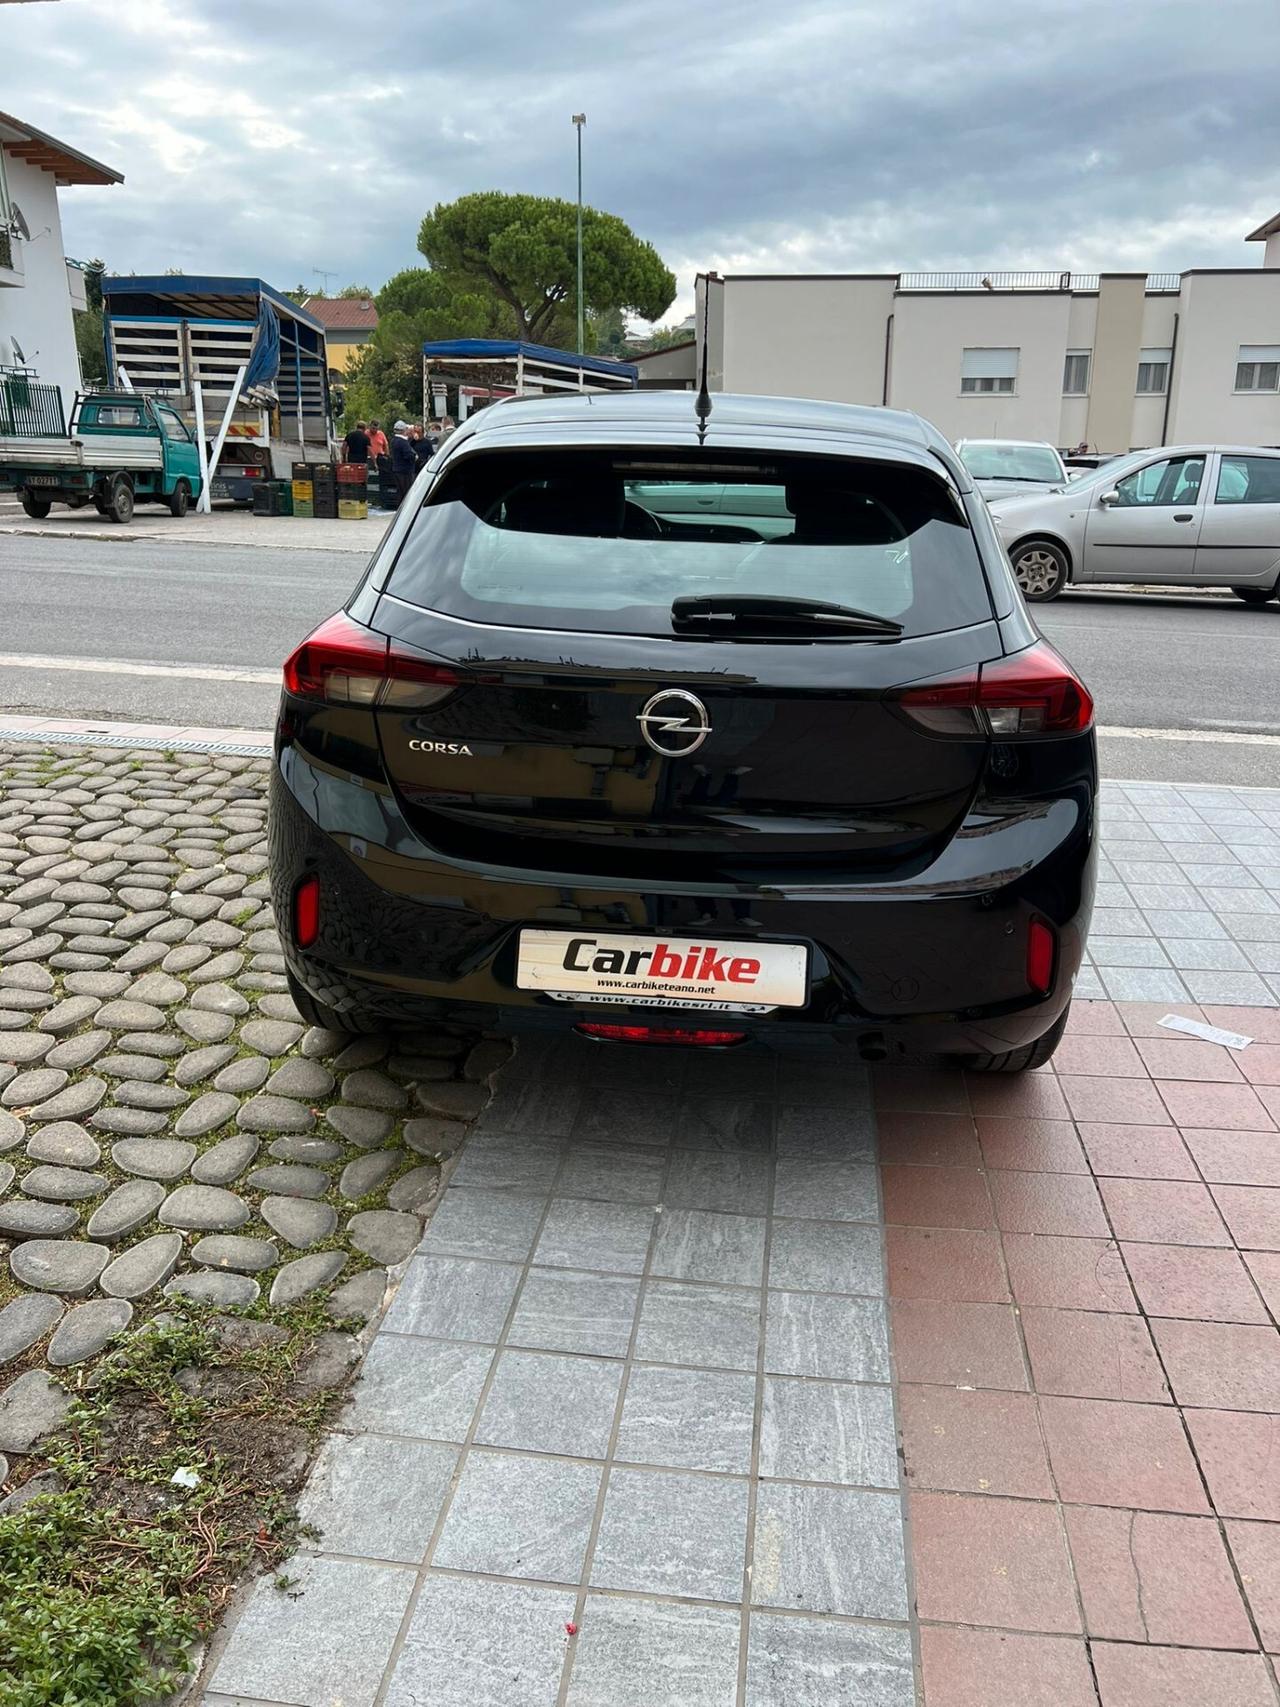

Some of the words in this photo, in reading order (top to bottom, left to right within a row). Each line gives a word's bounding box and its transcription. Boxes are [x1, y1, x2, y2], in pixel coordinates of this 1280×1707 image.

[408, 740, 473, 756] CORSA
[563, 938, 761, 983] Carbike
[597, 978, 716, 995] www.carbiketeano.net
[590, 995, 731, 1011] www.carbikesrl.it
